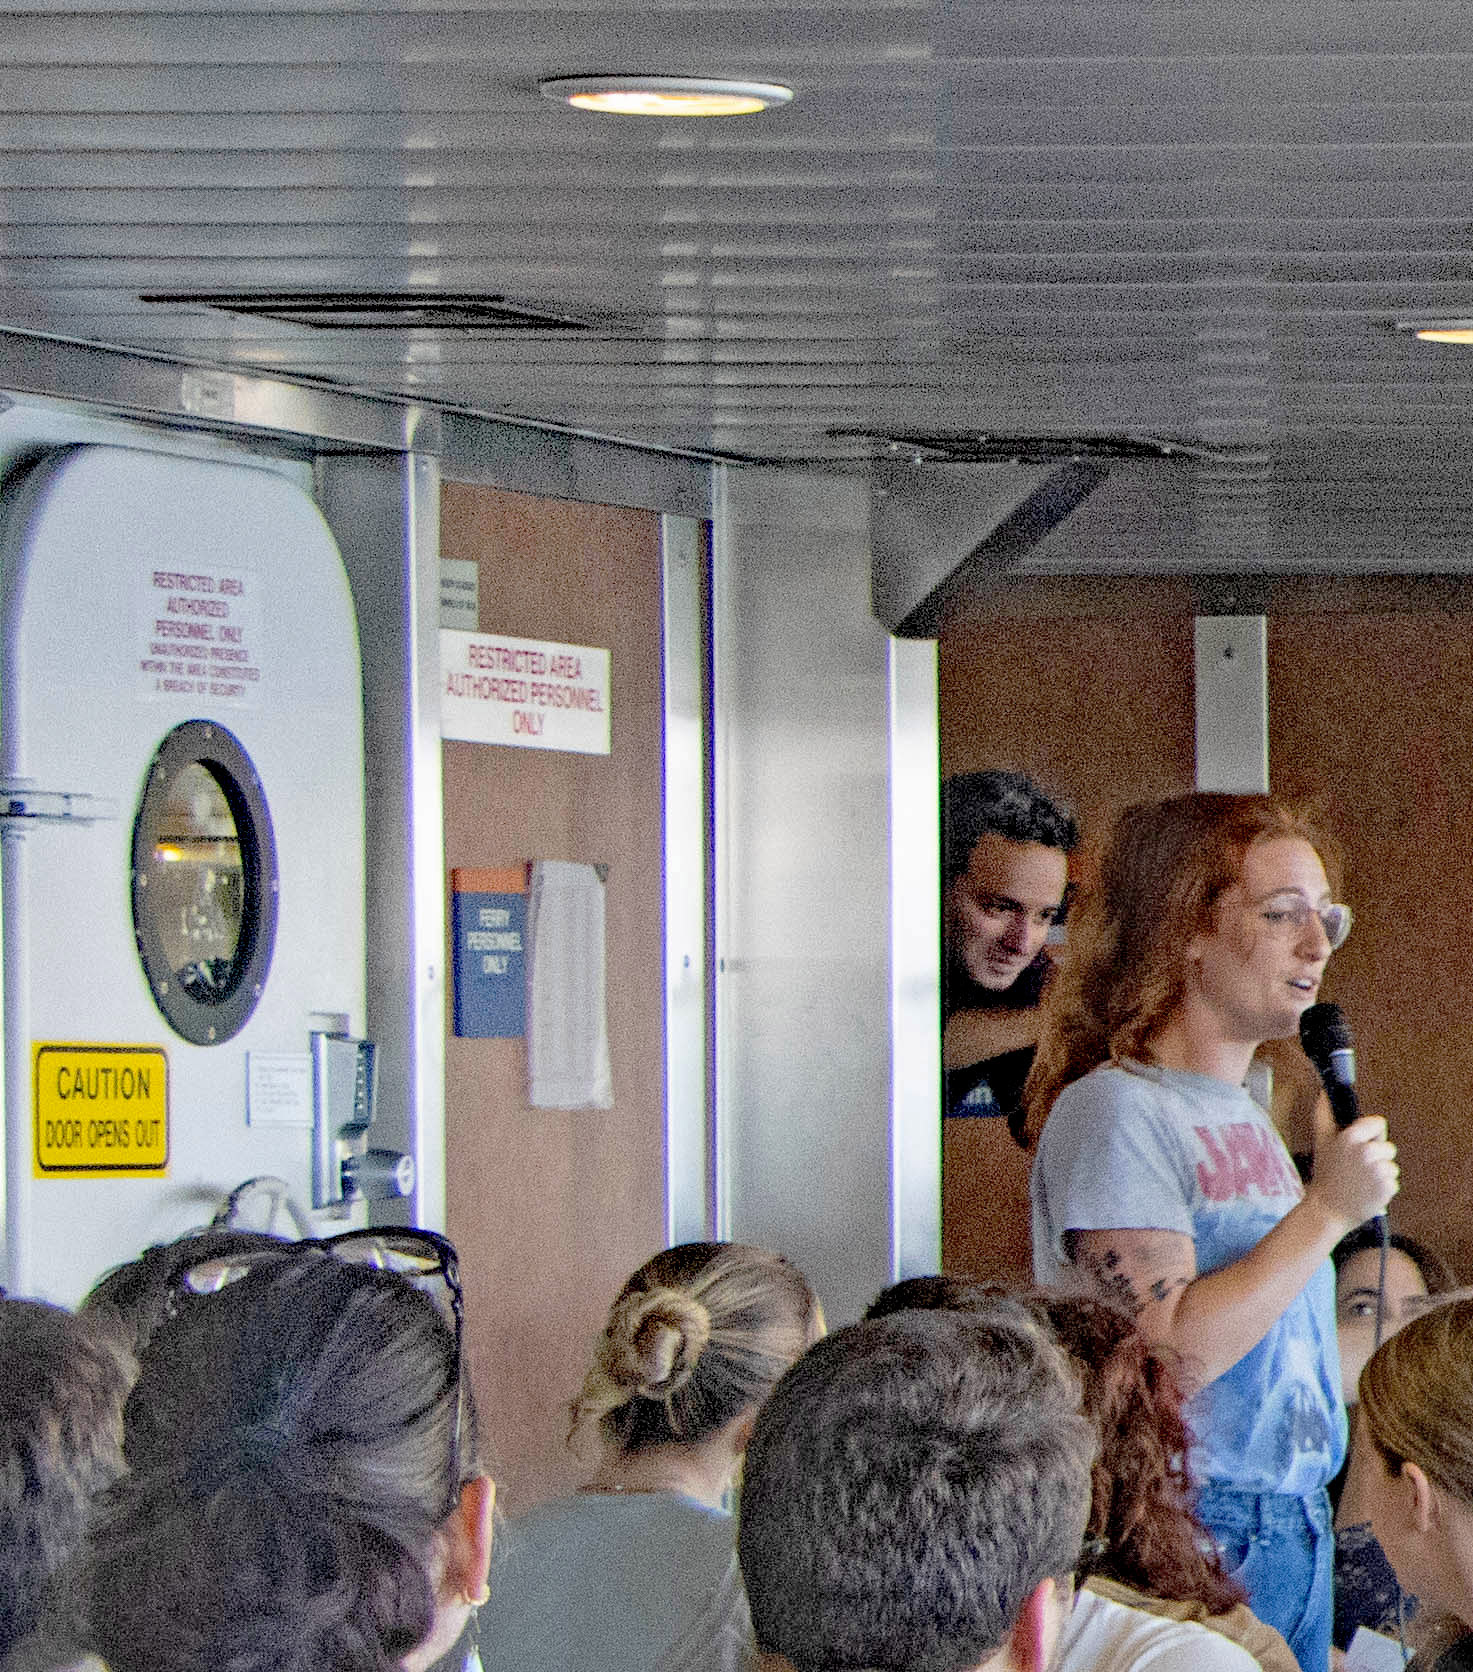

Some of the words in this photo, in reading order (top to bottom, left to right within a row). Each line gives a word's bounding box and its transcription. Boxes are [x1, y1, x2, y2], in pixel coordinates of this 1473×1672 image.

[153, 571, 214, 593] RESTRICTED
[220, 578, 243, 596] AREA
[167, 596, 229, 618] AUTHORIZED
[156, 620, 214, 641] PERSONNEL
[219, 625, 243, 643] ONLY
[469, 644, 546, 676] RESTRICTED
[551, 655, 583, 680] AREA
[448, 673, 527, 704] AUTHORIZED
[531, 681, 603, 713] PERSONNEL
[512, 709, 545, 736] ONLY
[57, 1066, 150, 1100] CAUTION
[46, 1119, 82, 1148] DOOR
[88, 1119, 130, 1148] OPENS
[136, 1119, 160, 1148] OUT
